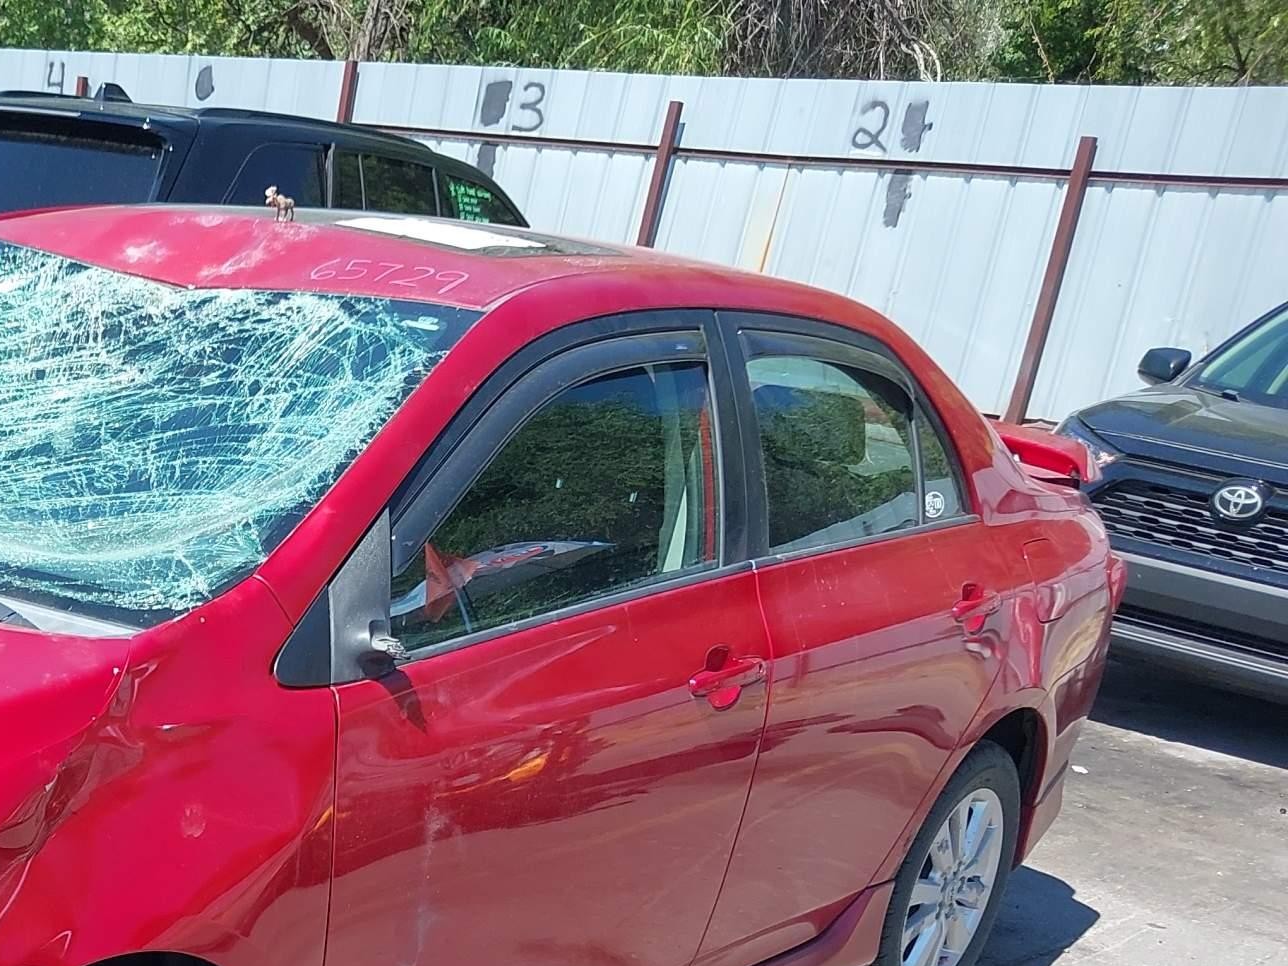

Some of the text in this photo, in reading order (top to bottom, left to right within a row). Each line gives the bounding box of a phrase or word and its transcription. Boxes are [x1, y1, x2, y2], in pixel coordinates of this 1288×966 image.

[46, 61, 65, 95] 4
[512, 82, 546, 132] 3
[851, 100, 890, 153] 2
[310, 257, 470, 295] 65729
